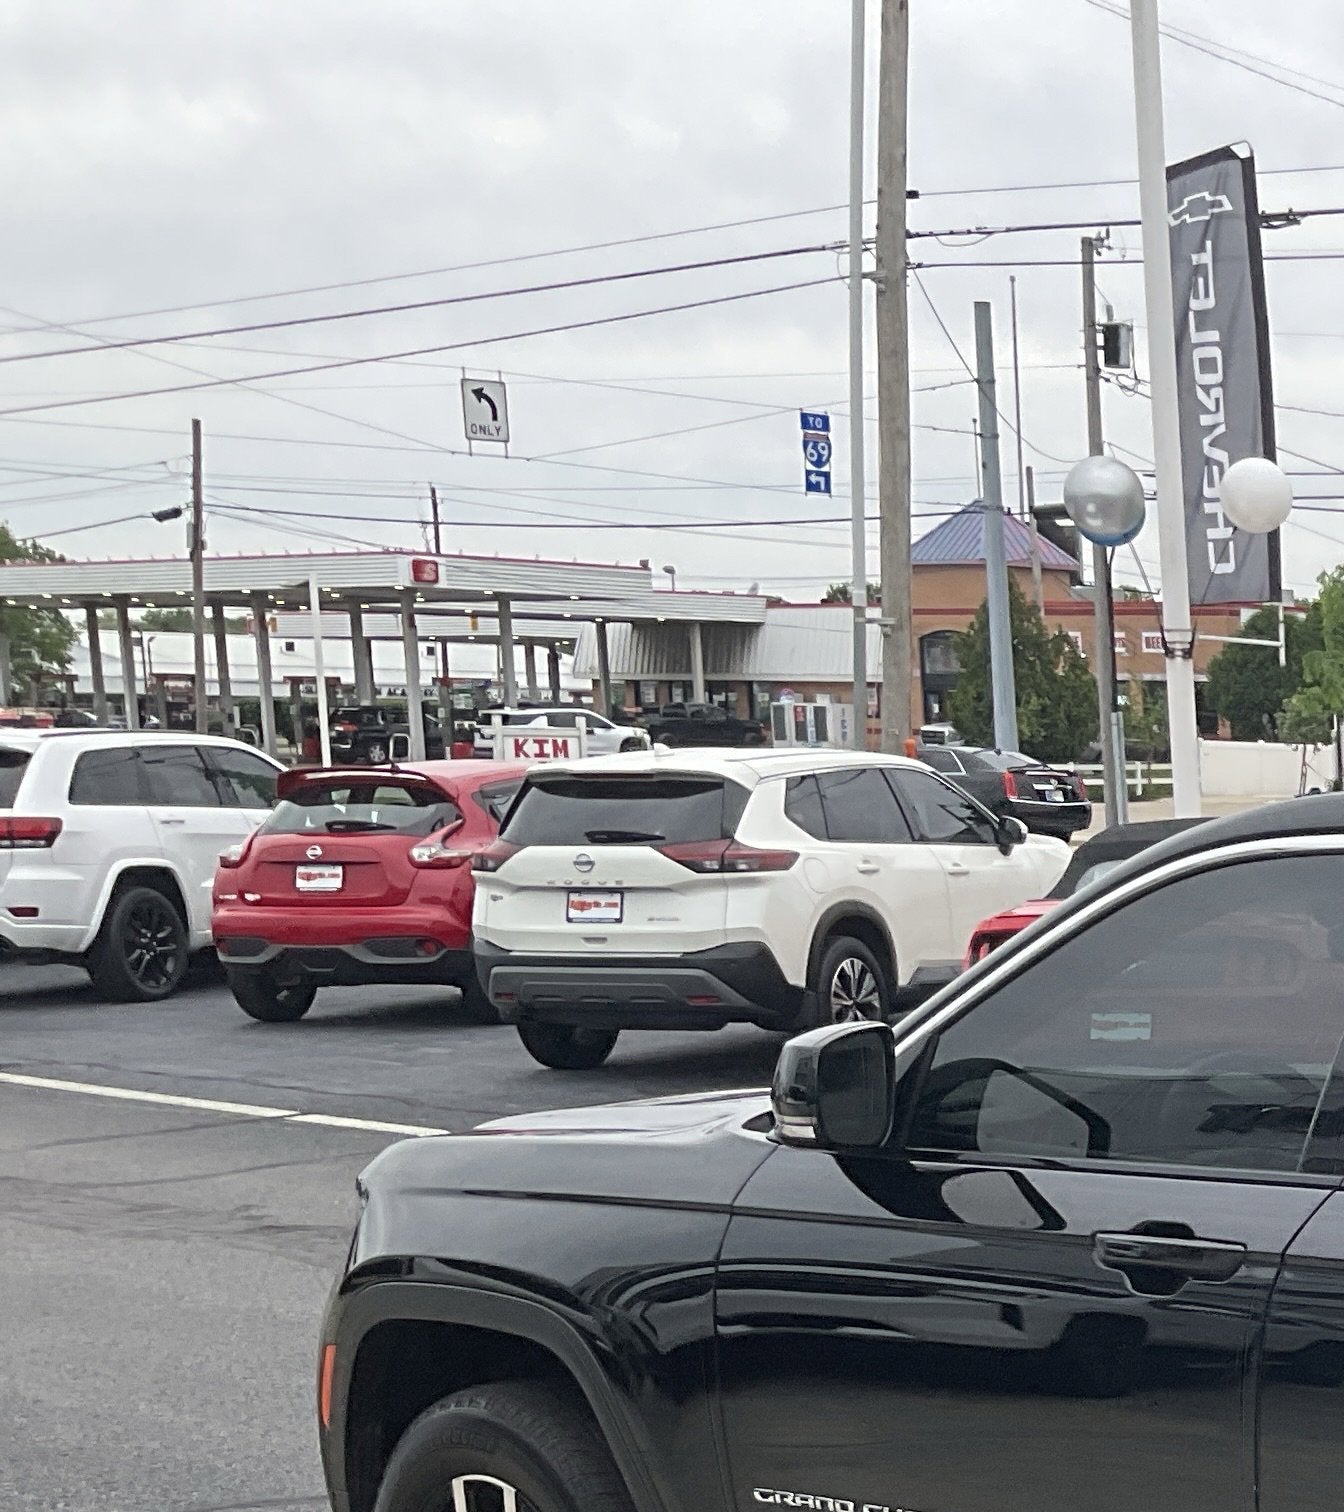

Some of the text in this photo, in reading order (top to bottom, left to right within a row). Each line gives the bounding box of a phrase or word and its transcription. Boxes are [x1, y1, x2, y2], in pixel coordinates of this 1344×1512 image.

[470, 422, 502, 437] ONLY
[807, 416, 823, 429] TO
[806, 442, 829, 462] 69
[514, 738, 570, 759] KIM
